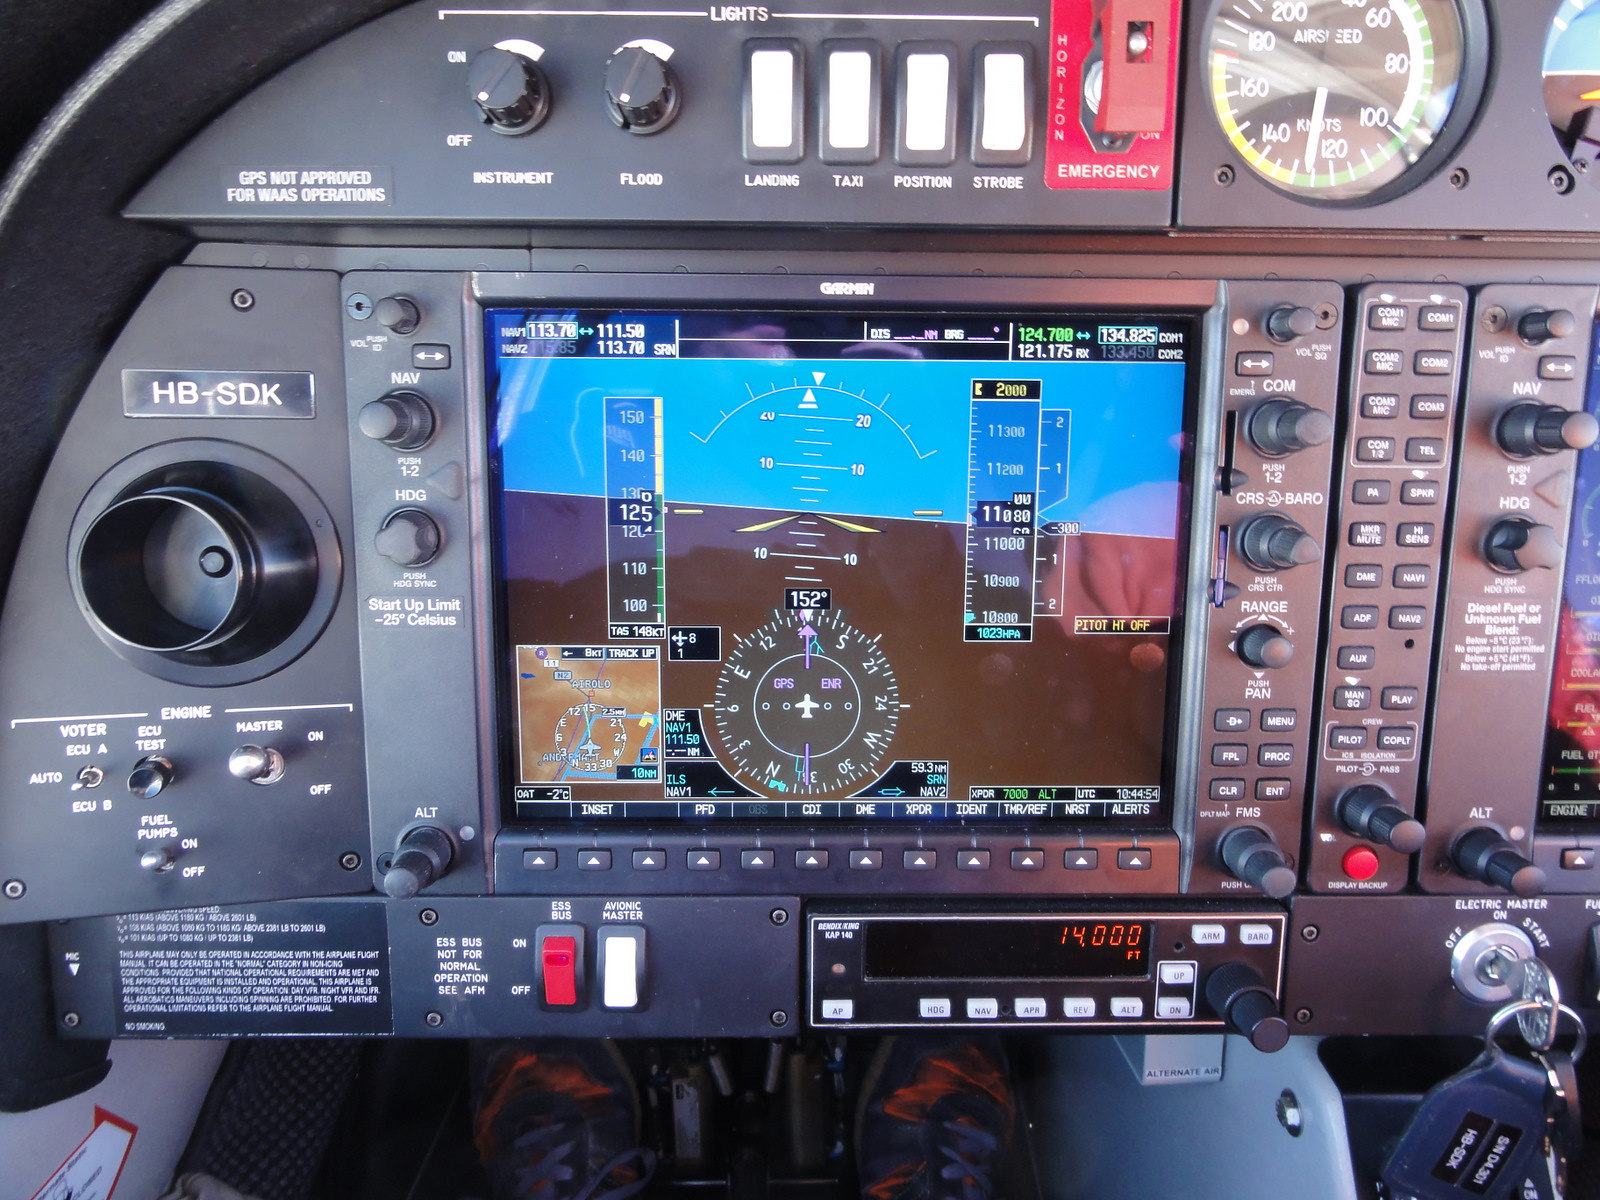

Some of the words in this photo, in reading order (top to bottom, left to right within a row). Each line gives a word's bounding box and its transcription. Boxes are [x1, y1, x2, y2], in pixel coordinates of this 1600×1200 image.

[711, 6, 768, 21] LIGHTS
[1272, 2, 1308, 21] 200
[1366, 8, 1391, 28] 60
[1249, 31, 1275, 51] 180
[448, 51, 466, 62] ON
[1385, 53, 1409, 73] 80
[1241, 77, 1269, 97] 160
[1360, 107, 1388, 127] 100
[1262, 123, 1290, 142] 140
[447, 135, 472, 146] OFF
[1321, 139, 1348, 158] 120
[1058, 165, 1160, 178] EMERGENCY
[239, 171, 267, 185] GPS
[270, 172, 297, 184] NOT
[300, 172, 371, 184] APPROVED
[473, 172, 553, 184] INSTRUMENT
[620, 173, 662, 185] FLOOD
[745, 175, 799, 187] LANDING
[832, 175, 864, 188] TAXI
[894, 176, 951, 189] POSITION
[973, 177, 1023, 189] STROBE
[227, 188, 255, 202] FOR
[258, 188, 298, 201] WAAS
[301, 188, 385, 202] OPERATIONS
[821, 282, 874, 295] GARMIN
[529, 324, 576, 337] 113.70
[597, 324, 645, 338] 111.50
[1018, 327, 1073, 342] 124.700
[1101, 328, 1155, 343] 134.825
[598, 341, 645, 354] 113.70
[654, 344, 676, 355] SRN
[1018, 344, 1072, 358] 121.175
[391, 372, 420, 384] NAV
[1263, 380, 1296, 392] COM
[1513, 382, 1542, 395] NAV
[153, 381, 282, 405] HB-SDK
[620, 411, 644, 423] 150
[989, 424, 1025, 437] 11300
[621, 450, 645, 461] 140
[401, 466, 419, 476] 1-2
[987, 463, 1023, 475] 11200
[1265, 472, 1282, 483] 1-2
[395, 490, 426, 500] HDG
[1410, 488, 1434, 497] SPKR
[1236, 493, 1264, 504] CRS
[1285, 493, 1323, 504] BARO
[1500, 497, 1529, 509] HDG
[620, 504, 652, 521] 125
[1403, 574, 1425, 582] NAV1
[369, 599, 401, 611] Start
[405, 600, 424, 613] Up
[428, 599, 460, 610] Limit
[1241, 601, 1288, 612] RANGE
[1468, 603, 1501, 613] Diesel
[1504, 603, 1526, 613] Fuel
[408, 614, 456, 625] Celsius
[1465, 614, 1515, 624] Unknown
[1518, 614, 1541, 624] Fuel
[1076, 620, 1108, 630] PITOT
[1112, 620, 1126, 630] HT
[1130, 620, 1150, 630] OFF
[611, 627, 629, 636] TAS
[1485, 626, 1519, 635] Blend:
[609, 649, 638, 658] TRACK
[642, 649, 654, 657] UP
[572, 680, 610, 688] AIROLO
[774, 679, 794, 689] GPS
[821, 679, 841, 689] ENR
[1245, 688, 1271, 699] PAN
[1392, 696, 1413, 704] PLAY
[161, 706, 211, 720] ENGINE
[666, 711, 685, 721] DME
[236, 720, 282, 732] MASTER
[1268, 717, 1294, 725] MENU
[60, 724, 106, 737] VOTER
[138, 726, 161, 736] ECU
[666, 722, 691, 732] NAV1
[308, 732, 323, 741] ON
[666, 735, 699, 744] 111.50
[1338, 736, 1362, 744] PILOT
[1384, 736, 1411, 745] COPLT
[136, 739, 166, 750] TEST
[67, 745, 90, 756] ECU
[98, 744, 107, 755] A
[1223, 752, 1239, 760] FPL
[1265, 753, 1290, 761] PROC
[30, 772, 62, 784] AUTO
[667, 775, 686, 784] ILS
[927, 775, 946, 784] SRN
[310, 785, 332, 795] OFF
[667, 787, 691, 796] NAV1
[920, 787, 946, 797] NAV2
[972, 790, 994, 798] XPDR
[1003, 789, 1028, 799] 7000
[1038, 789, 1057, 799] ALT
[1078, 790, 1095, 798] UTC
[1117, 789, 1158, 799] 10:44:54
[1219, 787, 1237, 795] CLR
[72, 801, 96, 812] ECU
[103, 801, 112, 811] B
[582, 804, 613, 814] INSET
[695, 804, 715, 814] PFD
[802, 804, 821, 815] CDI
[856, 804, 875, 815] DME
[906, 804, 932, 814] XPDR
[956, 804, 987, 814] IDENT
[1004, 805, 1047, 814] TMR/REF
[1065, 804, 1090, 814] NRST
[1112, 804, 1149, 814] ALERTS
[1550, 805, 1587, 816] ENGINE
[415, 808, 438, 818] ALT
[1236, 808, 1260, 817] FMS
[1469, 807, 1493, 818] ALT
[141, 815, 172, 826] FUEL
[138, 827, 178, 839] PUMPS
[182, 839, 197, 849] ON
[183, 867, 205, 877] OFF
[552, 902, 571, 910] ESS
[604, 902, 641, 910] AVIONIC
[1456, 900, 1501, 909] ELECTRIC
[1507, 900, 1547, 909] MASTER
[552, 911, 572, 920] BUS
[602, 911, 643, 920] MASTER
[1493, 911, 1507, 920] ON
[825, 931, 840, 939] KAP
[841, 931, 852, 939] 140
[1062, 926, 1141, 947] 14,000
[1523, 918, 1549, 948] START
[437, 938, 456, 947] ESS
[462, 938, 482, 947] BUS
[513, 939, 526, 948] ON
[438, 950, 456, 958] NOT
[463, 950, 482, 958] FOR
[440, 962, 480, 971] NORMAL
[434, 974, 488, 982] OPERATION
[1174, 972, 1185, 980] UP
[438, 986, 457, 994] SEE
[464, 986, 485, 994] AFM
[512, 986, 530, 995] OFF
[927, 1006, 944, 1014] HDG
[125, 1022, 135, 1030] NO
[1146, 1069, 1200, 1078] ALTERNATE
[1204, 1067, 1220, 1075] AIR
[1446, 1128, 1479, 1169] HB-SDK
